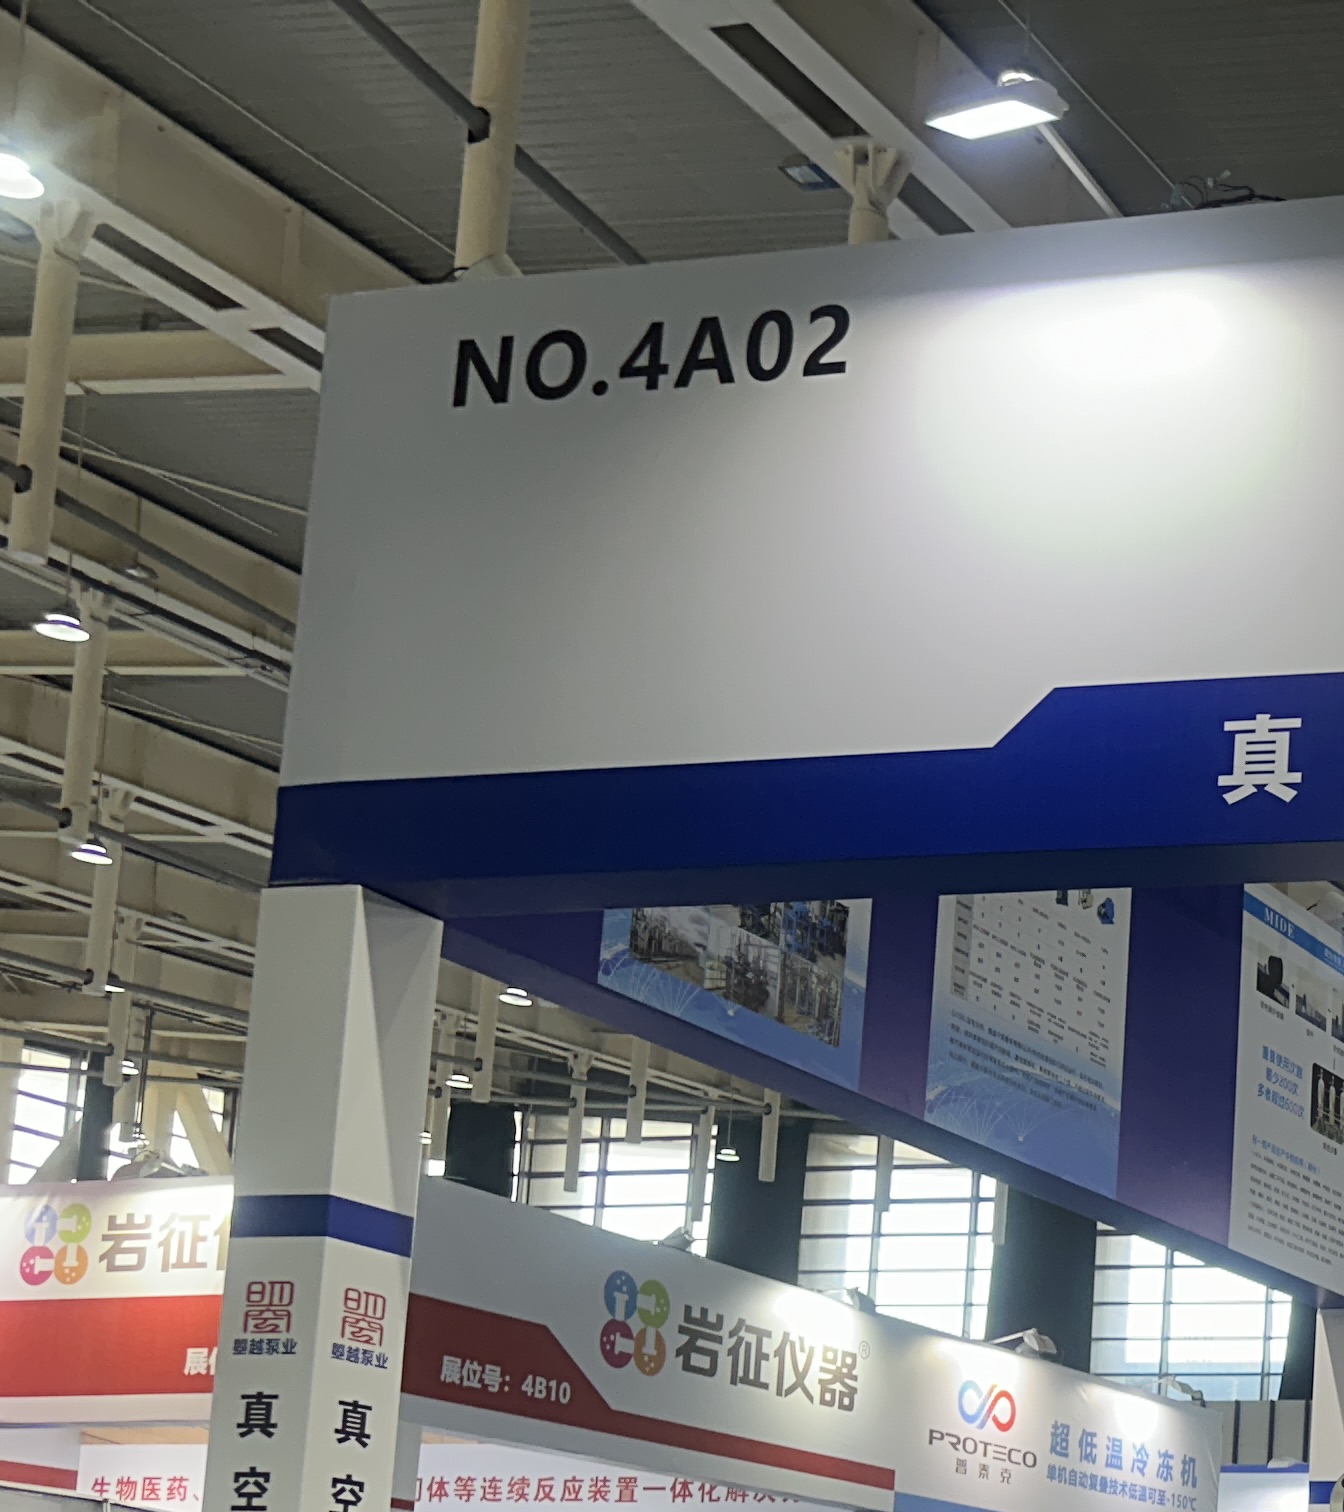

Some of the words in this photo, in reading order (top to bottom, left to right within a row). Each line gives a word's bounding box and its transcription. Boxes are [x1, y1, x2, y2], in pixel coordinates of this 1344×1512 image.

[453, 304, 850, 407] NO.4A02
[1264, 907, 1295, 939] MIDE
[675, 1304, 860, 1413] 岩征仪器
[928, 1428, 1037, 1468] PROTECO
[1050, 1420, 1198, 1488] 超低温冷冻机
